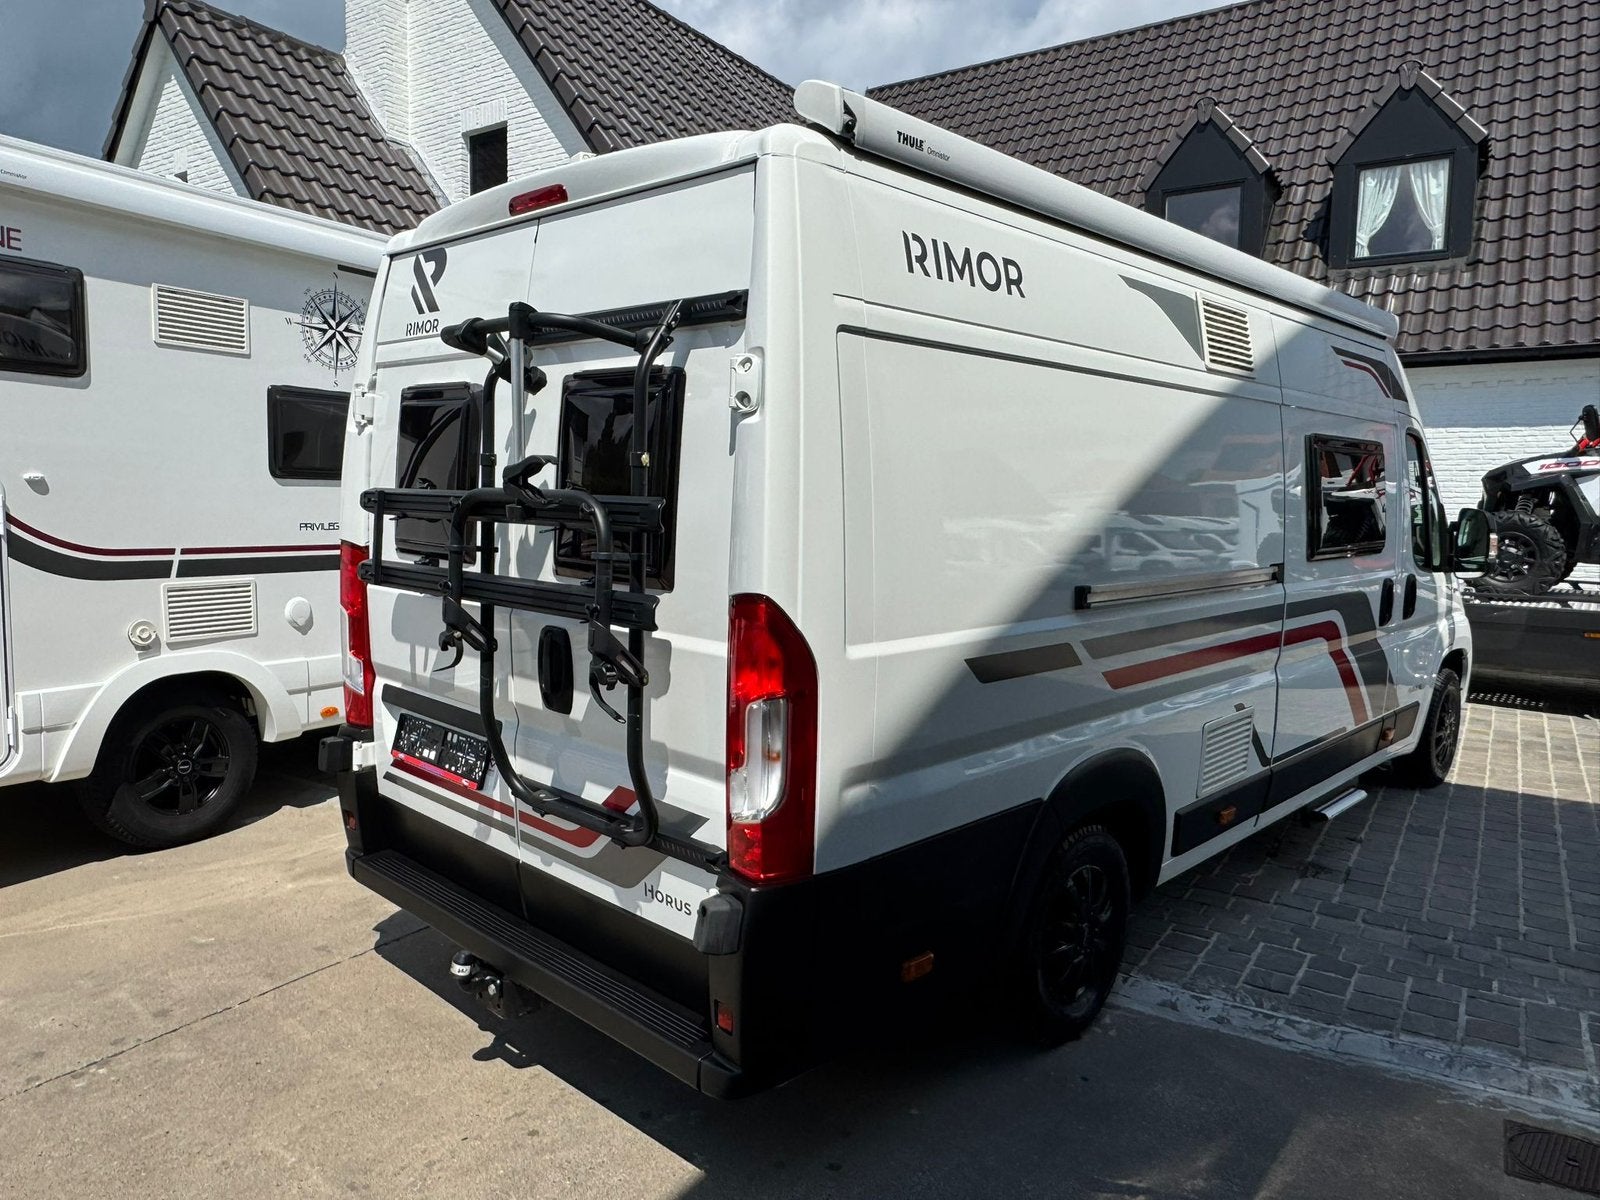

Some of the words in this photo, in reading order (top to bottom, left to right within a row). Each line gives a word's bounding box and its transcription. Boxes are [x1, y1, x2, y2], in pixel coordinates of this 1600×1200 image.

[897, 130, 924, 151] THULE
[902, 230, 1026, 298] RIMOR
[405, 318, 440, 337] RIMOR
[644, 881, 692, 916] HORUS
